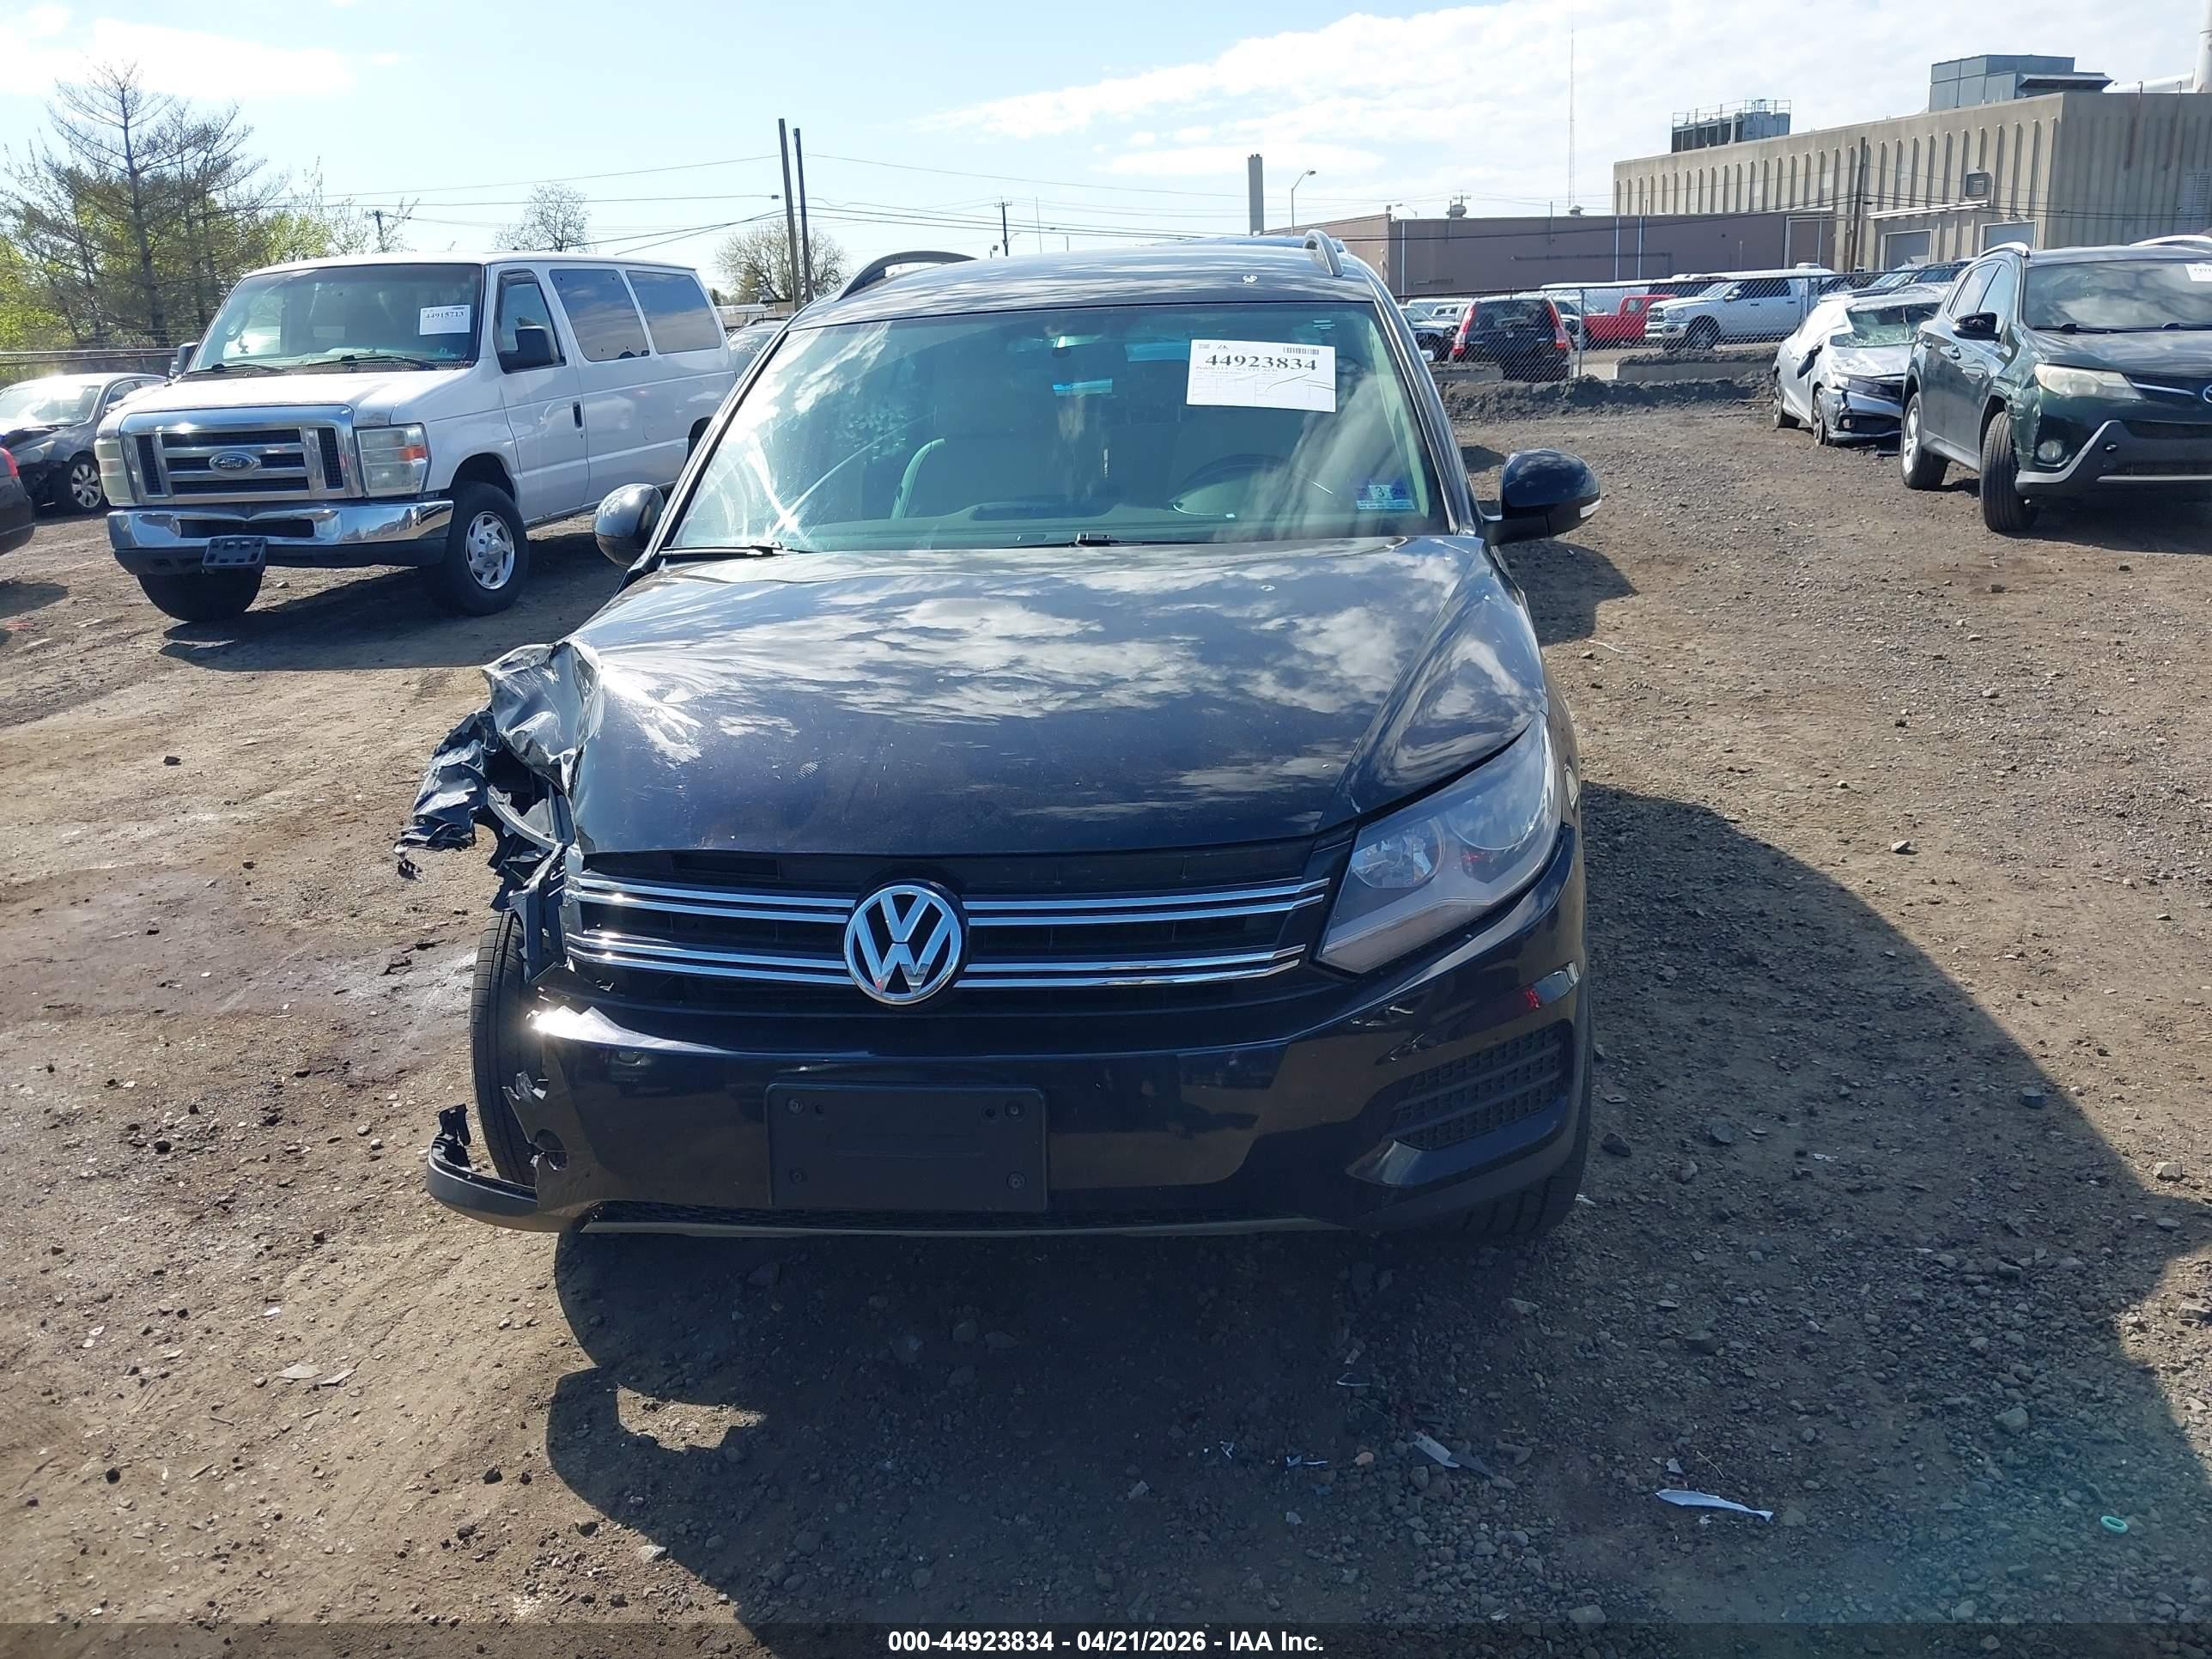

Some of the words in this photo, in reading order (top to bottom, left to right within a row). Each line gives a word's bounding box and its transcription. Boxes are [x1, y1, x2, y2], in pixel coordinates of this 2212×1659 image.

[1204, 354, 1318, 371] 44923834
[1374, 486, 1385, 497] 3
[848, 889, 957, 1000] VW
